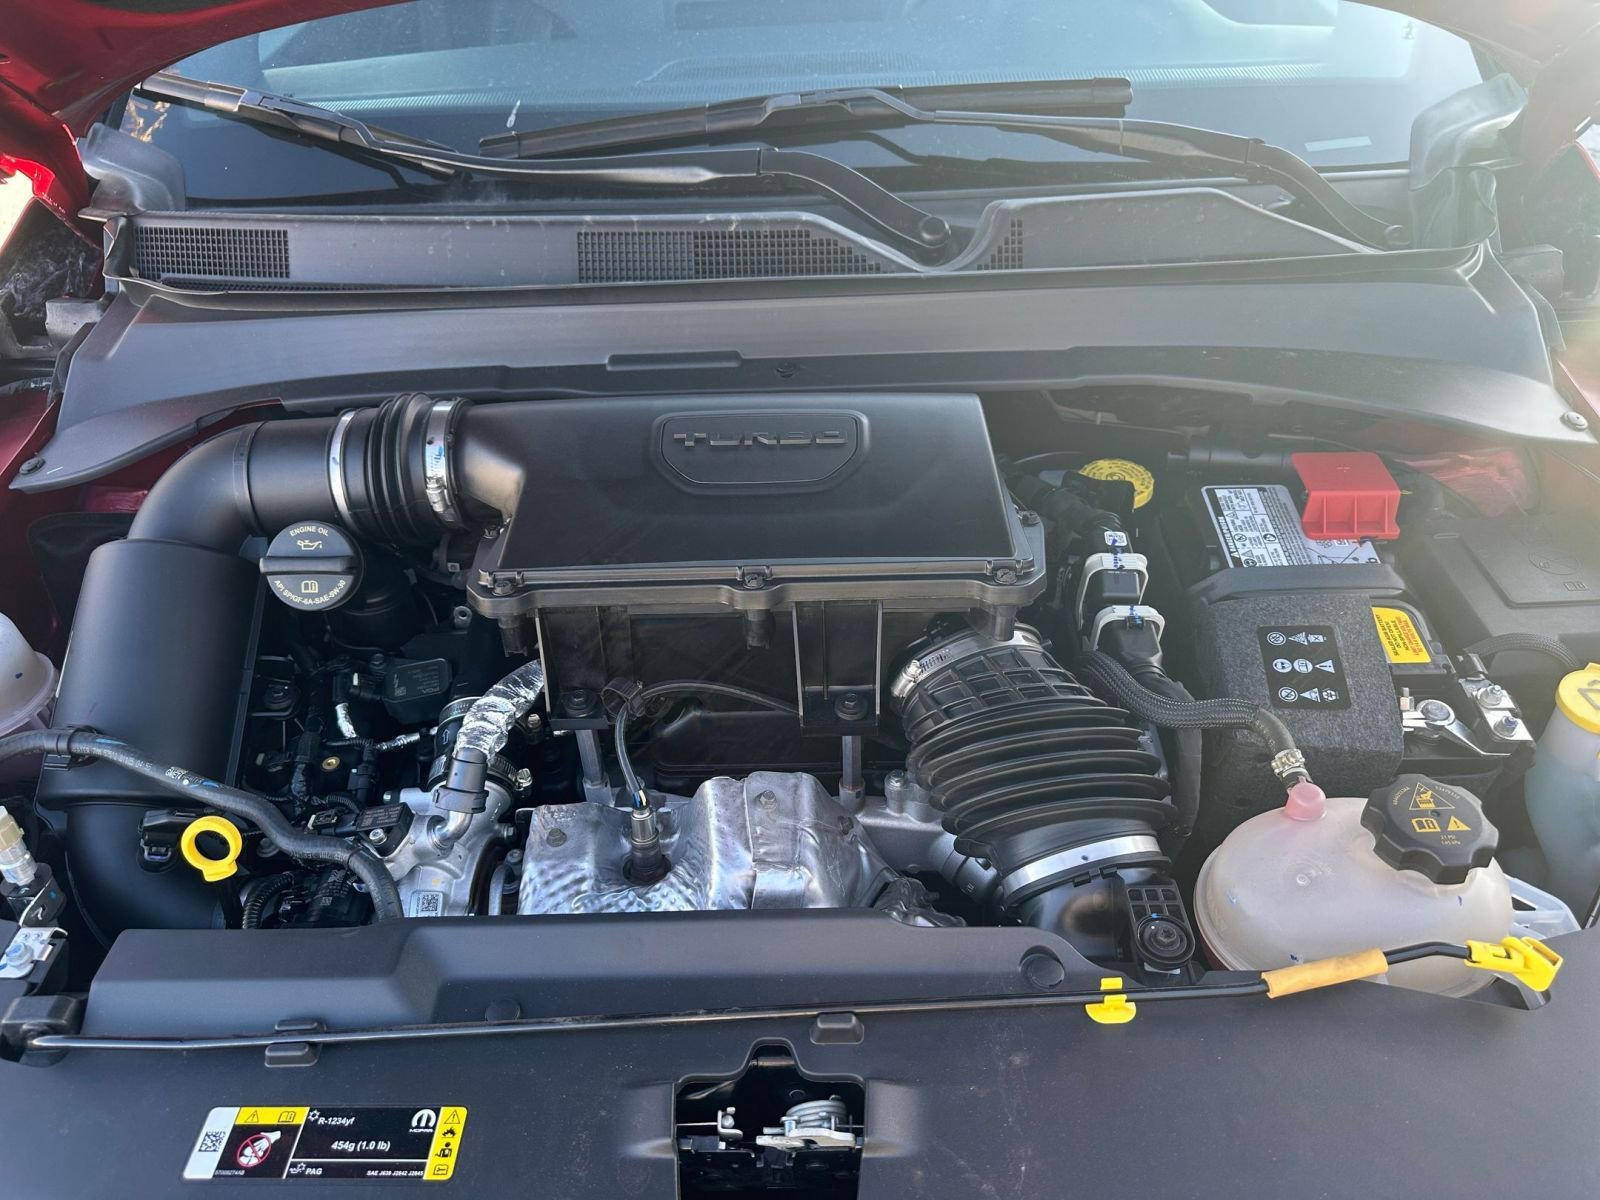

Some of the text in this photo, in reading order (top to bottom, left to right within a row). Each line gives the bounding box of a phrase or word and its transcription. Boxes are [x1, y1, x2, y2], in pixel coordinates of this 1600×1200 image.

[289, 526, 329, 537] ENGINE OIL
[274, 580, 285, 592] API
[317, 1117, 355, 1126] R-1234yf
[330, 1140, 391, 1152] 454g (1.0 lb)
[305, 1167, 323, 1176] PAG
